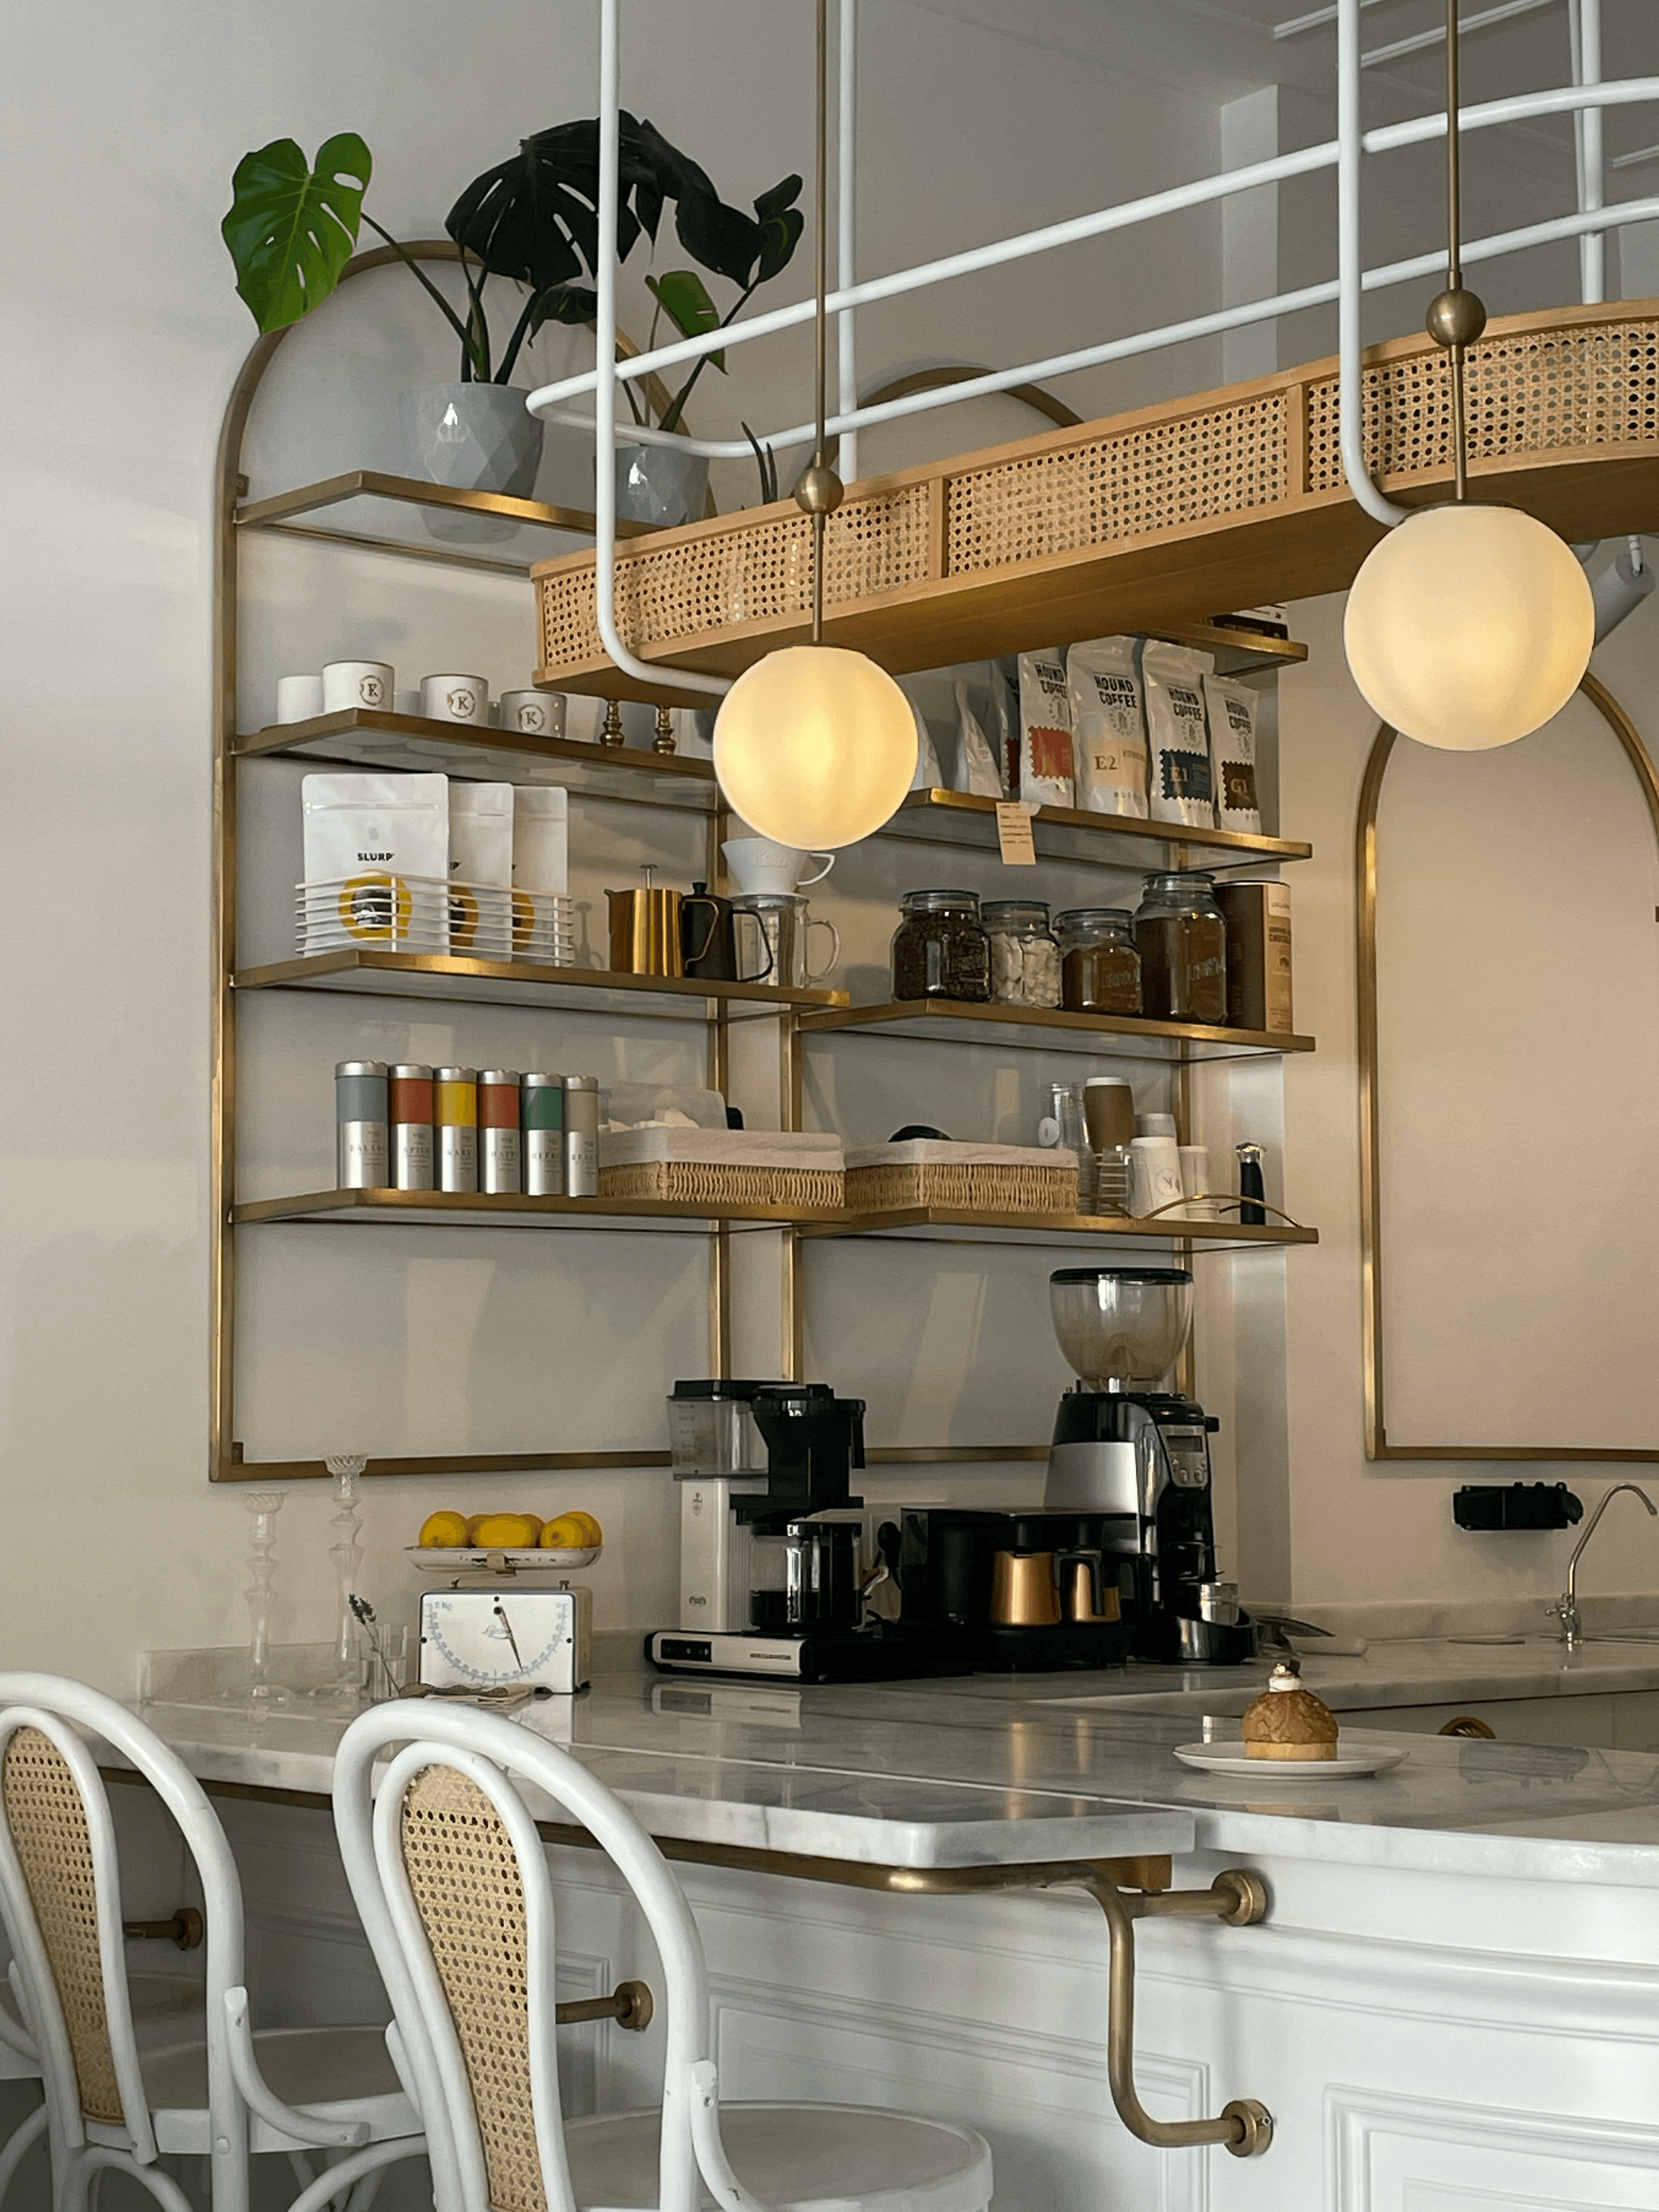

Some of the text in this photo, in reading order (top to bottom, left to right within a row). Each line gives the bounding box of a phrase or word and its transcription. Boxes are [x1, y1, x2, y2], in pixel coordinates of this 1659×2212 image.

[1093, 674, 1135, 693] HOUND
[458, 696, 469, 710] K
[1098, 691, 1138, 709] COFFEE
[526, 711, 538, 726] K
[1172, 702, 1203, 721] COFFEE
[1094, 755, 1118, 771] E2
[358, 853, 393, 861] SLURP
